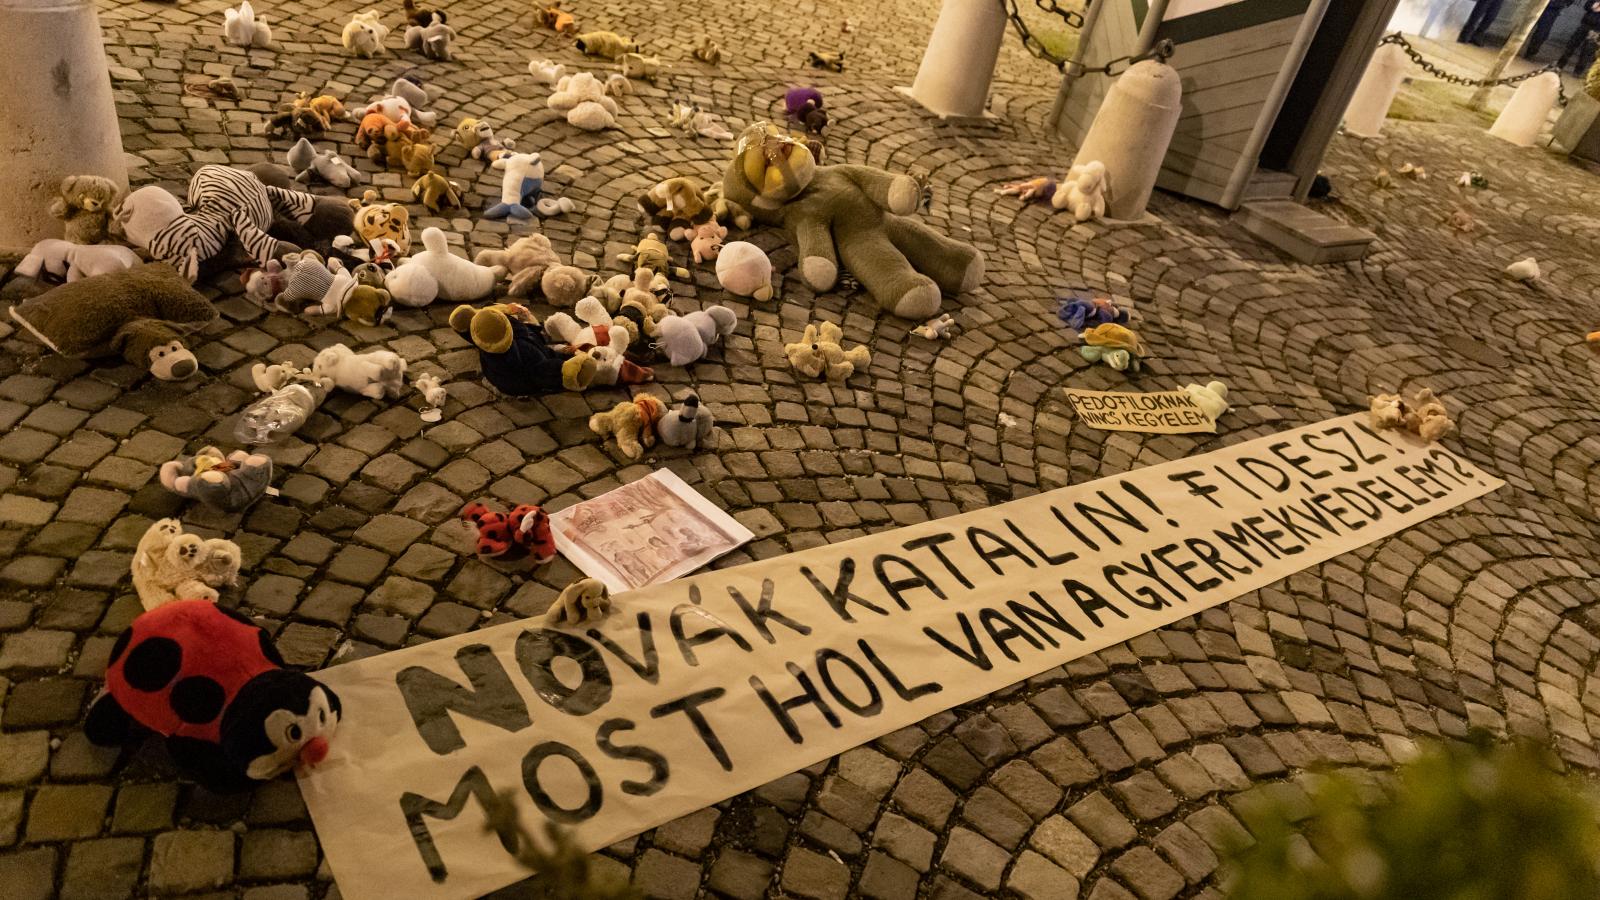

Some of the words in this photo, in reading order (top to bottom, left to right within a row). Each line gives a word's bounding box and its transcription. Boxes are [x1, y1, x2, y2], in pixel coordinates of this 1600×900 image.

[1068, 393, 1198, 411] PEDOFILOKNAK
[1080, 410, 1122, 426] NINCS
[1121, 411, 1212, 428] KEGYELEM
[396, 577, 812, 756] NOVÁK
[800, 480, 1180, 623] KATALIN!
[1167, 421, 1406, 508] FIDESZ!
[400, 686, 734, 884] MOST
[748, 638, 944, 744] HOL
[922, 591, 1086, 671] VAN
